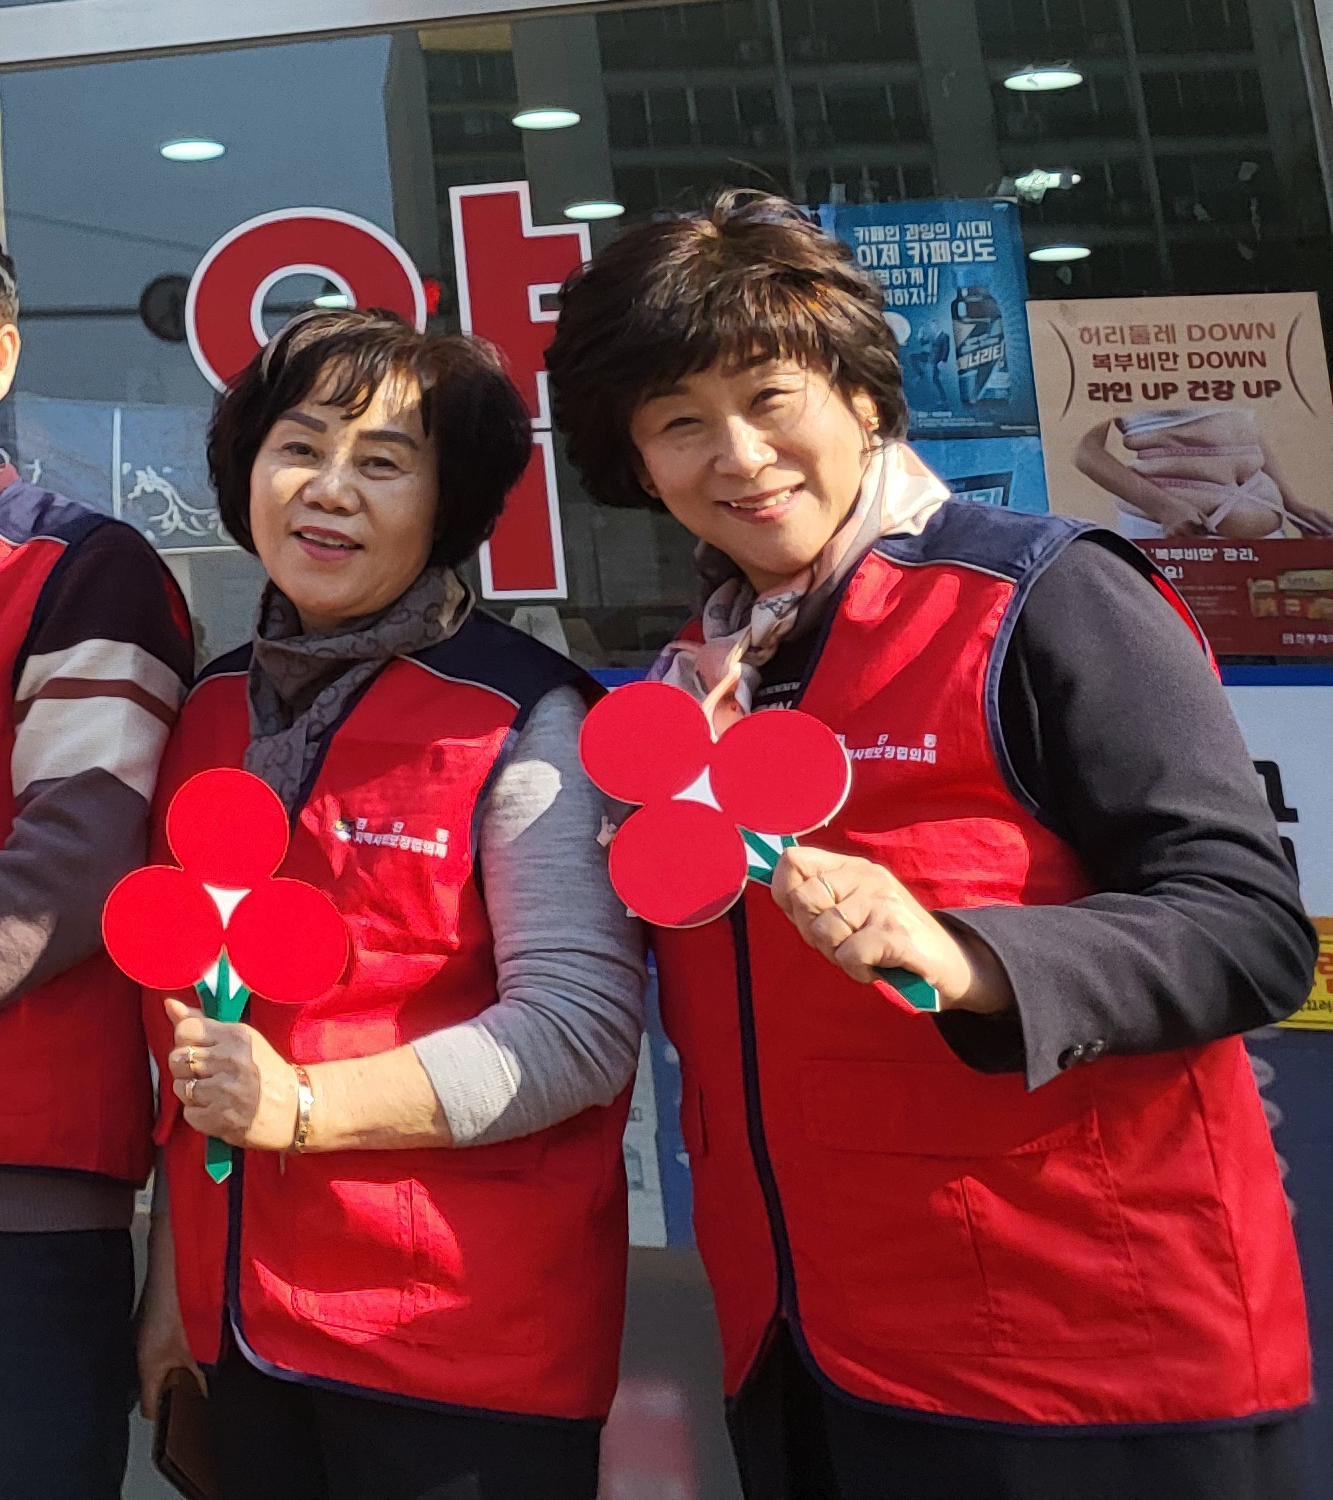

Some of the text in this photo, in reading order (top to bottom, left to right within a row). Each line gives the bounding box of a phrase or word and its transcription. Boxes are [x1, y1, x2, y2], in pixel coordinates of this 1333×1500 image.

[857, 238, 998, 267] 이제 카페인도
[1079, 321, 1277, 346] 허리둘레 DOWN
[1092, 350, 1267, 373] 복부비만 DOWN
[1087, 379, 1282, 403] 라인 UP 건강 UP
